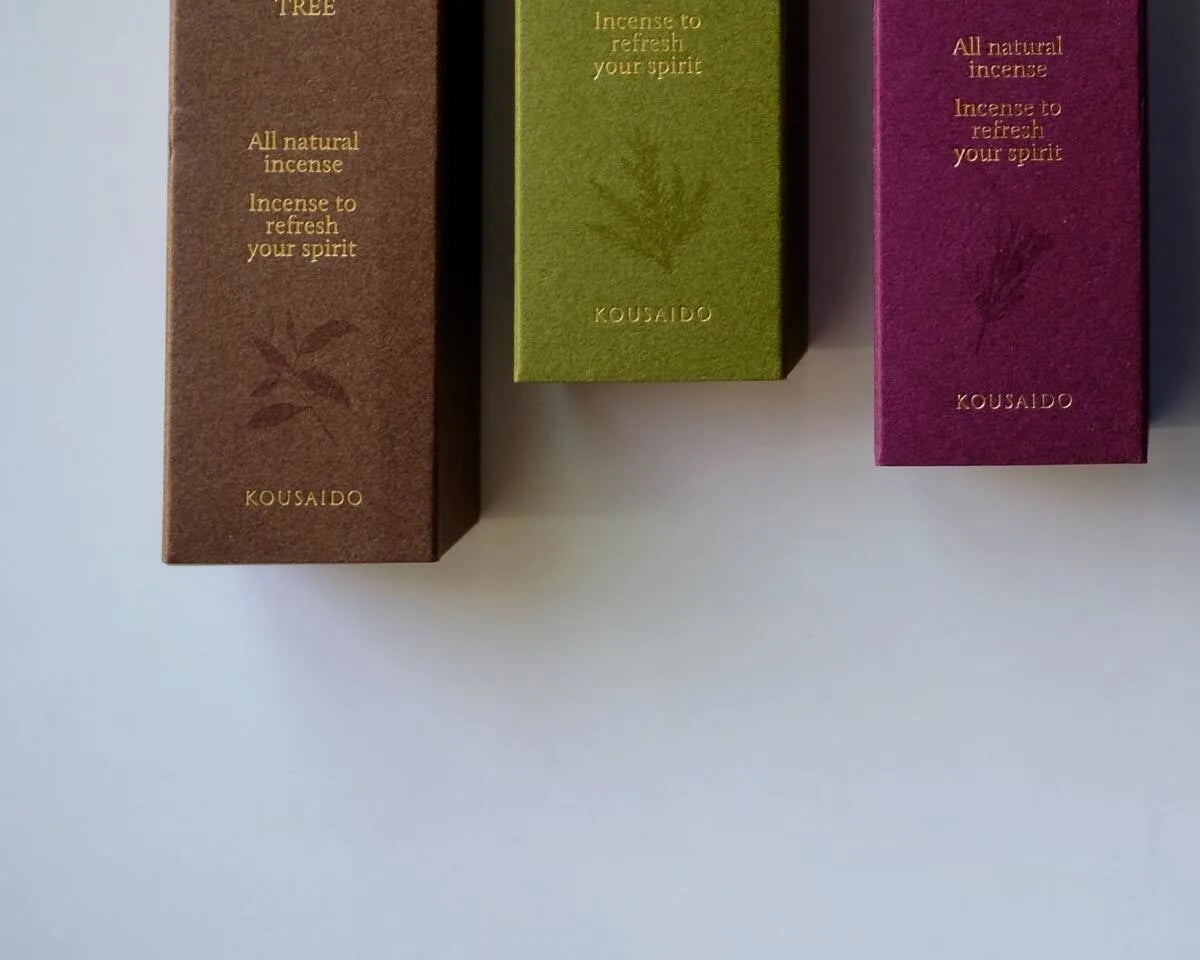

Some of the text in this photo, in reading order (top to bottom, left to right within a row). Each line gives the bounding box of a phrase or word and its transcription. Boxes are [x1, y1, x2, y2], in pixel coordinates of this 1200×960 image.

[594, 11, 701, 30] Incense to
[611, 32, 684, 52] refresh
[952, 35, 1063, 56] All natural
[593, 56, 702, 81] your spirit
[968, 60, 1048, 79] incense
[954, 98, 1062, 117] Incense to
[971, 119, 1046, 139] refresh
[248, 131, 360, 150] All natural
[264, 155, 343, 173] incense
[953, 143, 1063, 168] your spirit
[249, 193, 357, 212] Incense to
[265, 215, 339, 235] refresh
[247, 239, 357, 263] your spirit
[593, 305, 712, 324] KOUSAIDO
[956, 393, 1072, 410] KOUSAIDO
[245, 490, 363, 507] KOUSAIDO
